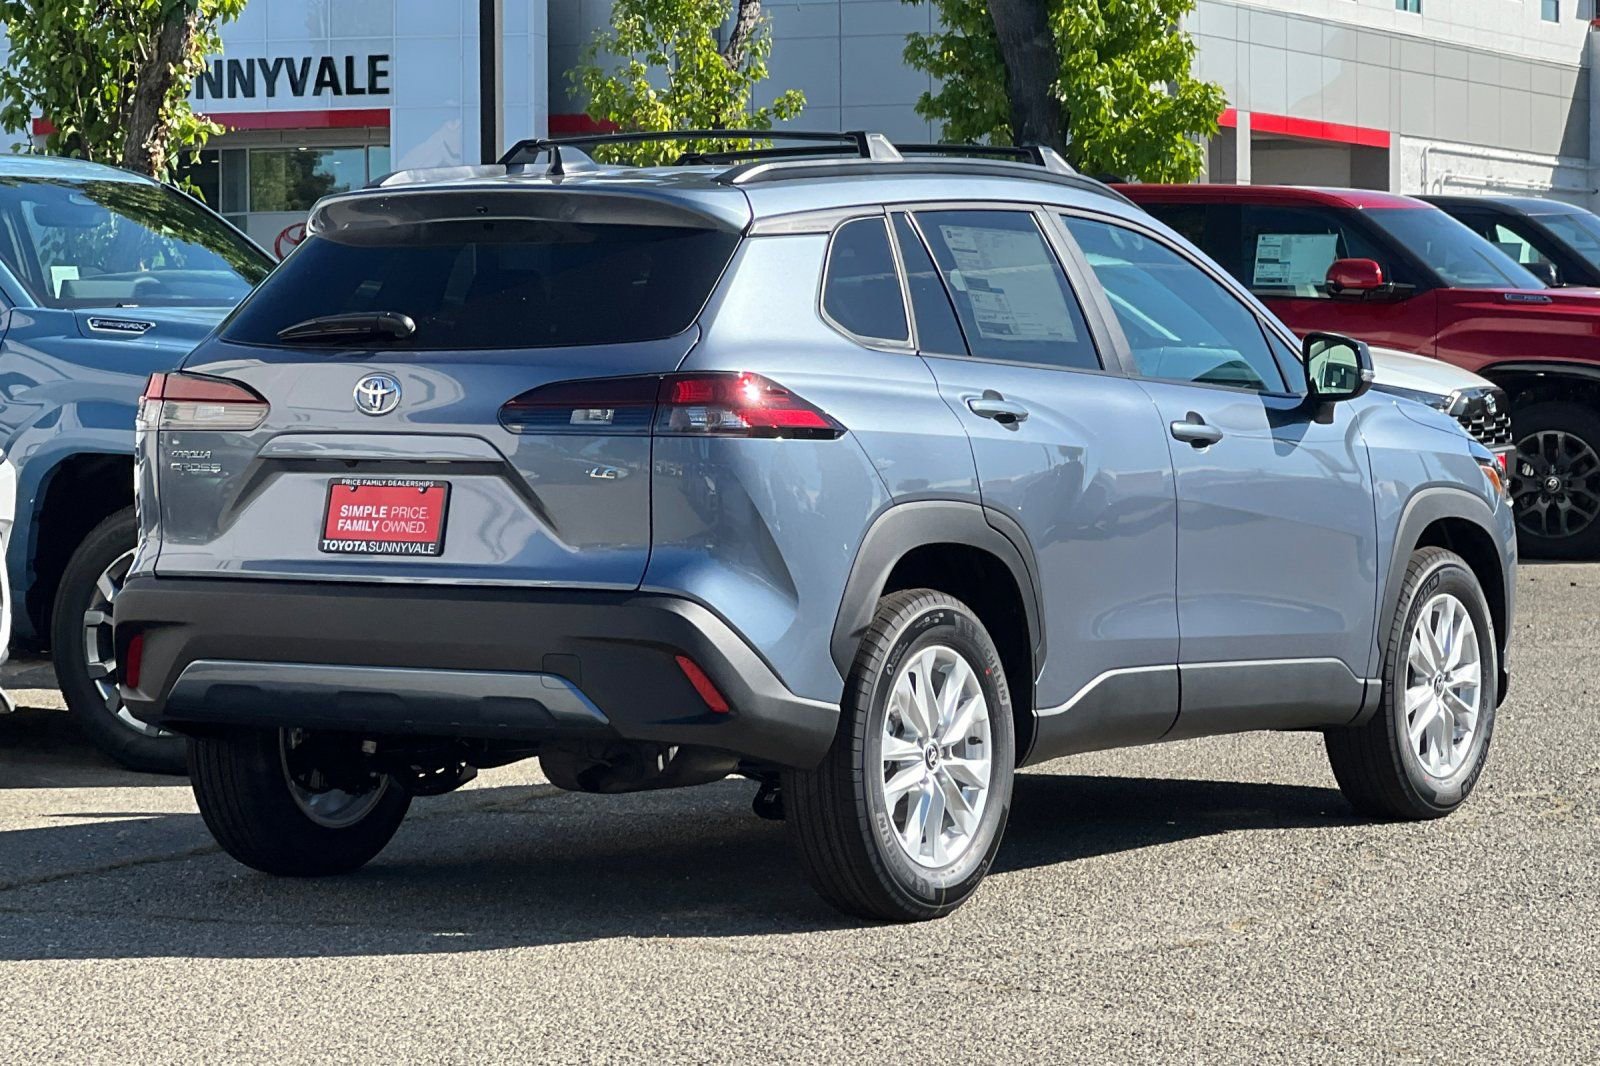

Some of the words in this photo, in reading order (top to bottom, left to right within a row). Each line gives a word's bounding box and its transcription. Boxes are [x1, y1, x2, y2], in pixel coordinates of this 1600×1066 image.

[187, 54, 390, 100] NNYVALE
[590, 467, 615, 479] LE
[387, 480, 434, 488] DEALERSHIPS
[340, 504, 388, 518] SIMPLE
[390, 506, 430, 520] PRICE.
[337, 519, 379, 532] FAMILY
[381, 520, 428, 534] OWNED.
[322, 539, 367, 552] TOYOTA
[368, 541, 436, 554] SUNNYVALE
